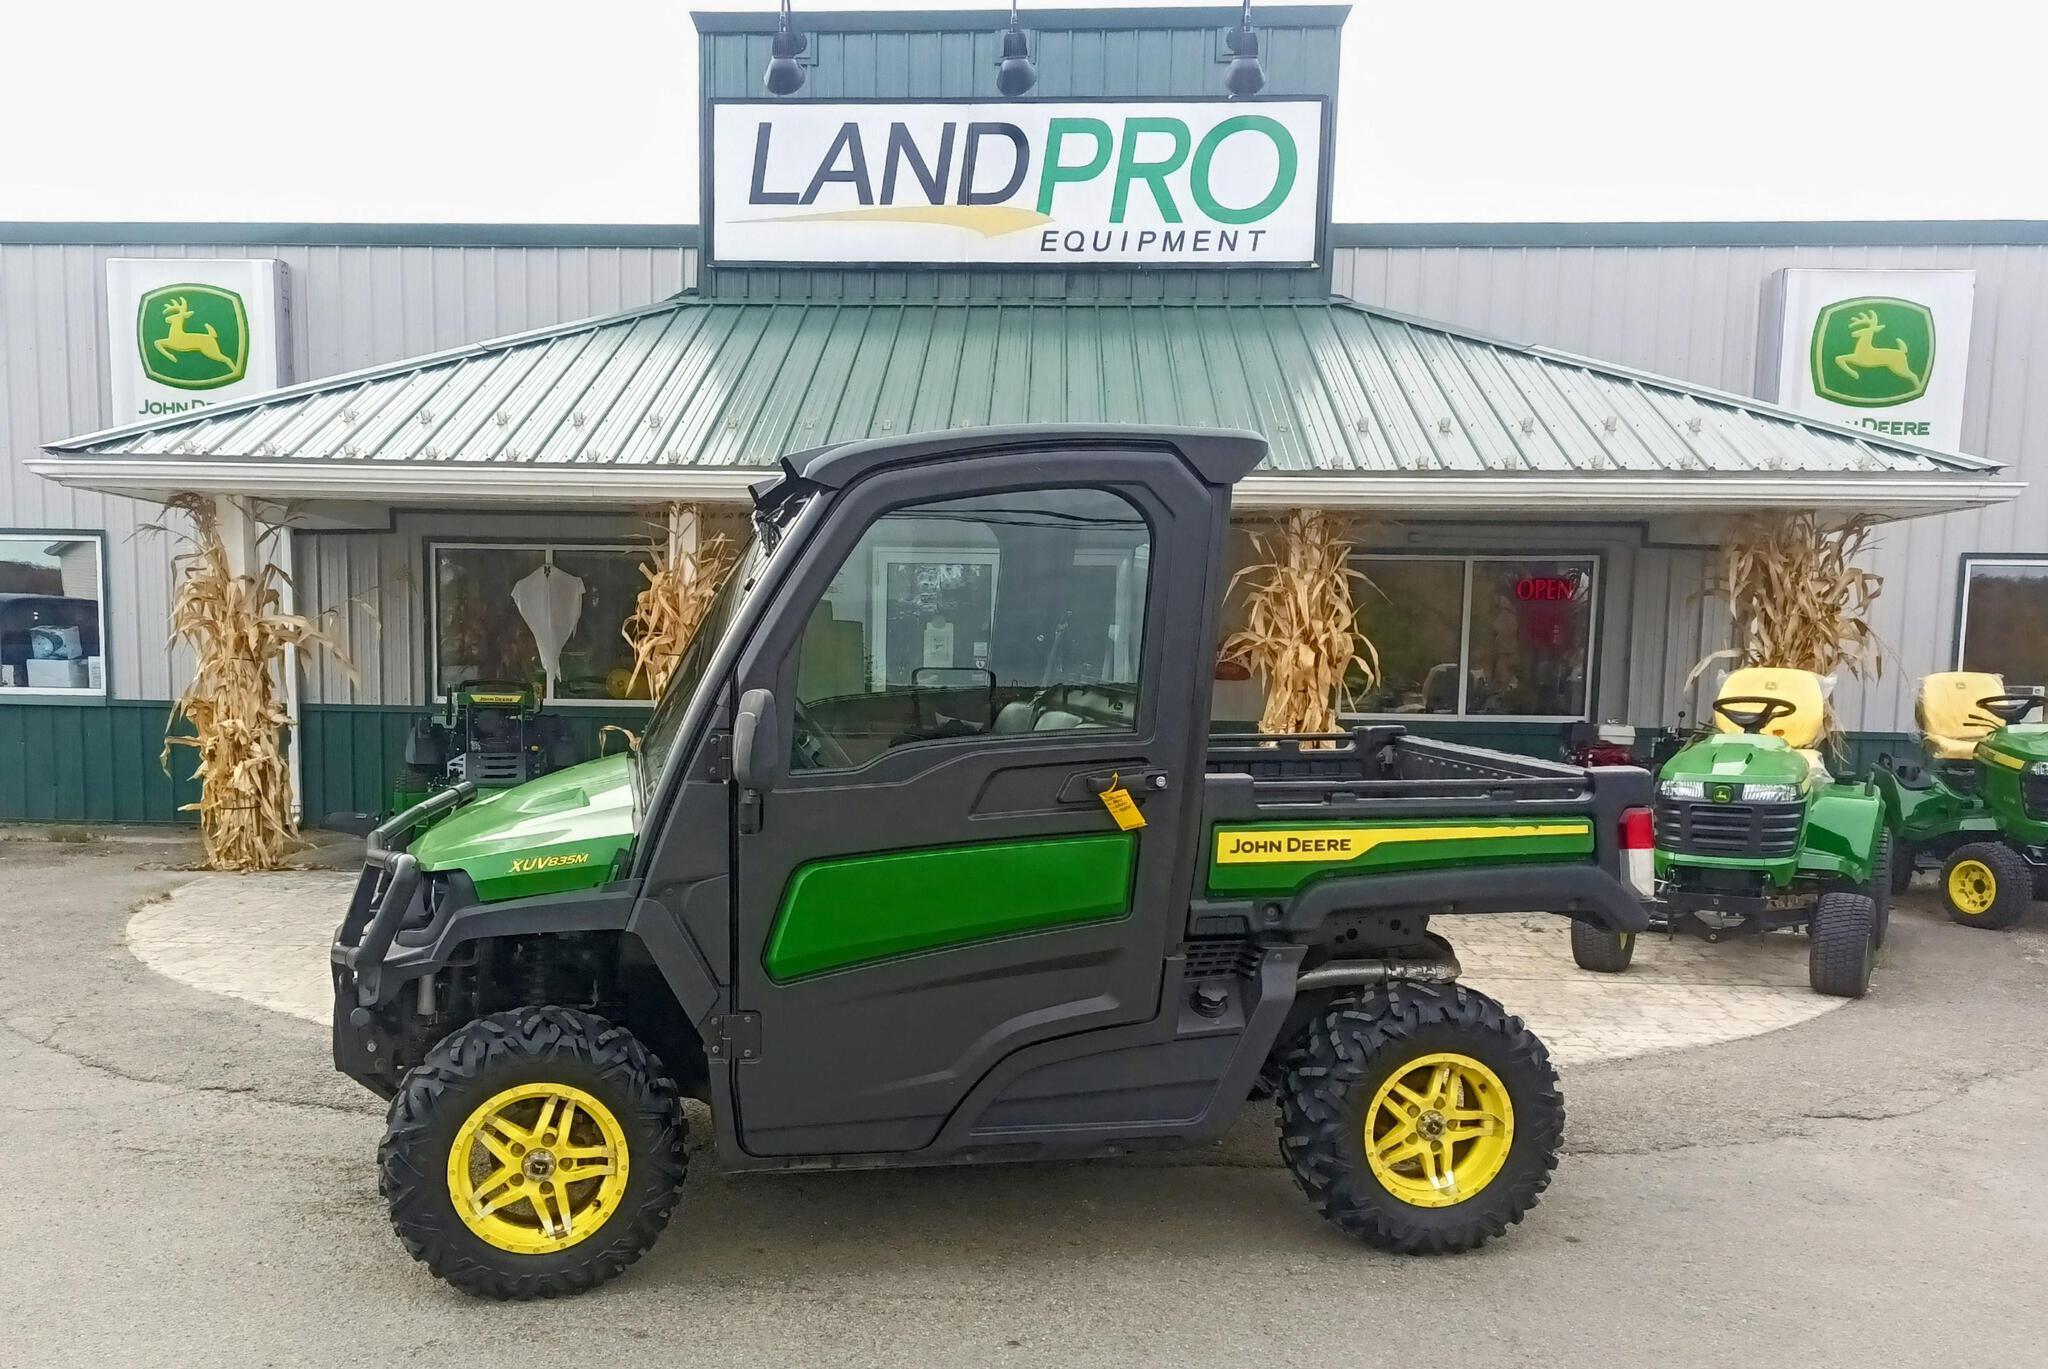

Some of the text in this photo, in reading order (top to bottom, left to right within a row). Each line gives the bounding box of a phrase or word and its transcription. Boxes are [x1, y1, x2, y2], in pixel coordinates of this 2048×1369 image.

[748, 114, 1298, 225] LANDPRO
[1040, 230, 1267, 252] EQUIPMENT
[138, 399, 189, 415] JOHN
[1516, 578, 1573, 600] OPEN
[1230, 837, 1351, 854] JOHN DEERE
[507, 852, 590, 873] XUV835M
